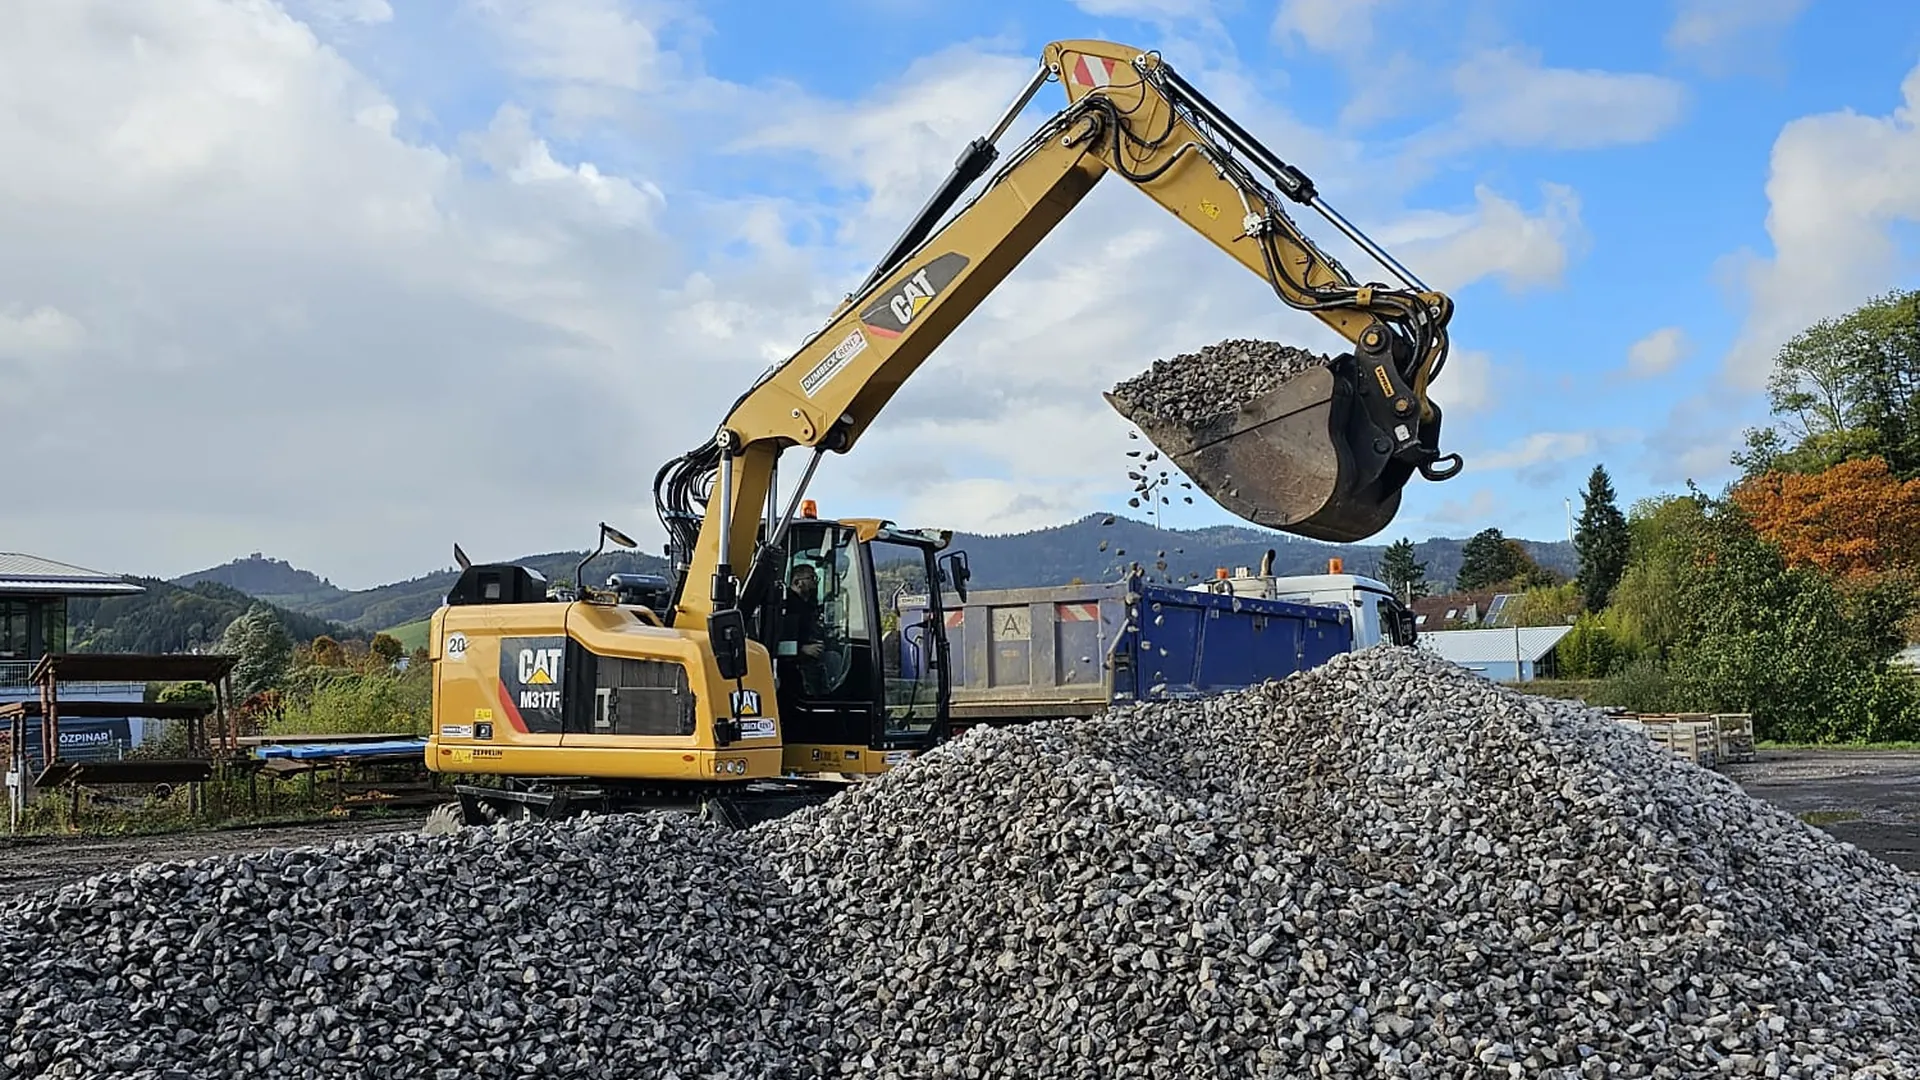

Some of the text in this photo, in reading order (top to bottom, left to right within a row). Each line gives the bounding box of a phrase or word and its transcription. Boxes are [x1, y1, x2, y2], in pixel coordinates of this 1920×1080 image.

[890, 267, 936, 324] CAT
[803, 353, 838, 389] DUMBECK
[838, 336, 858, 357] RENT
[1001, 613, 1020, 637] A
[449, 637, 465, 653] 20
[518, 648, 562, 684] CAT
[520, 691, 561, 708] M317F
[59, 732, 108, 743] ÖZPINAR
